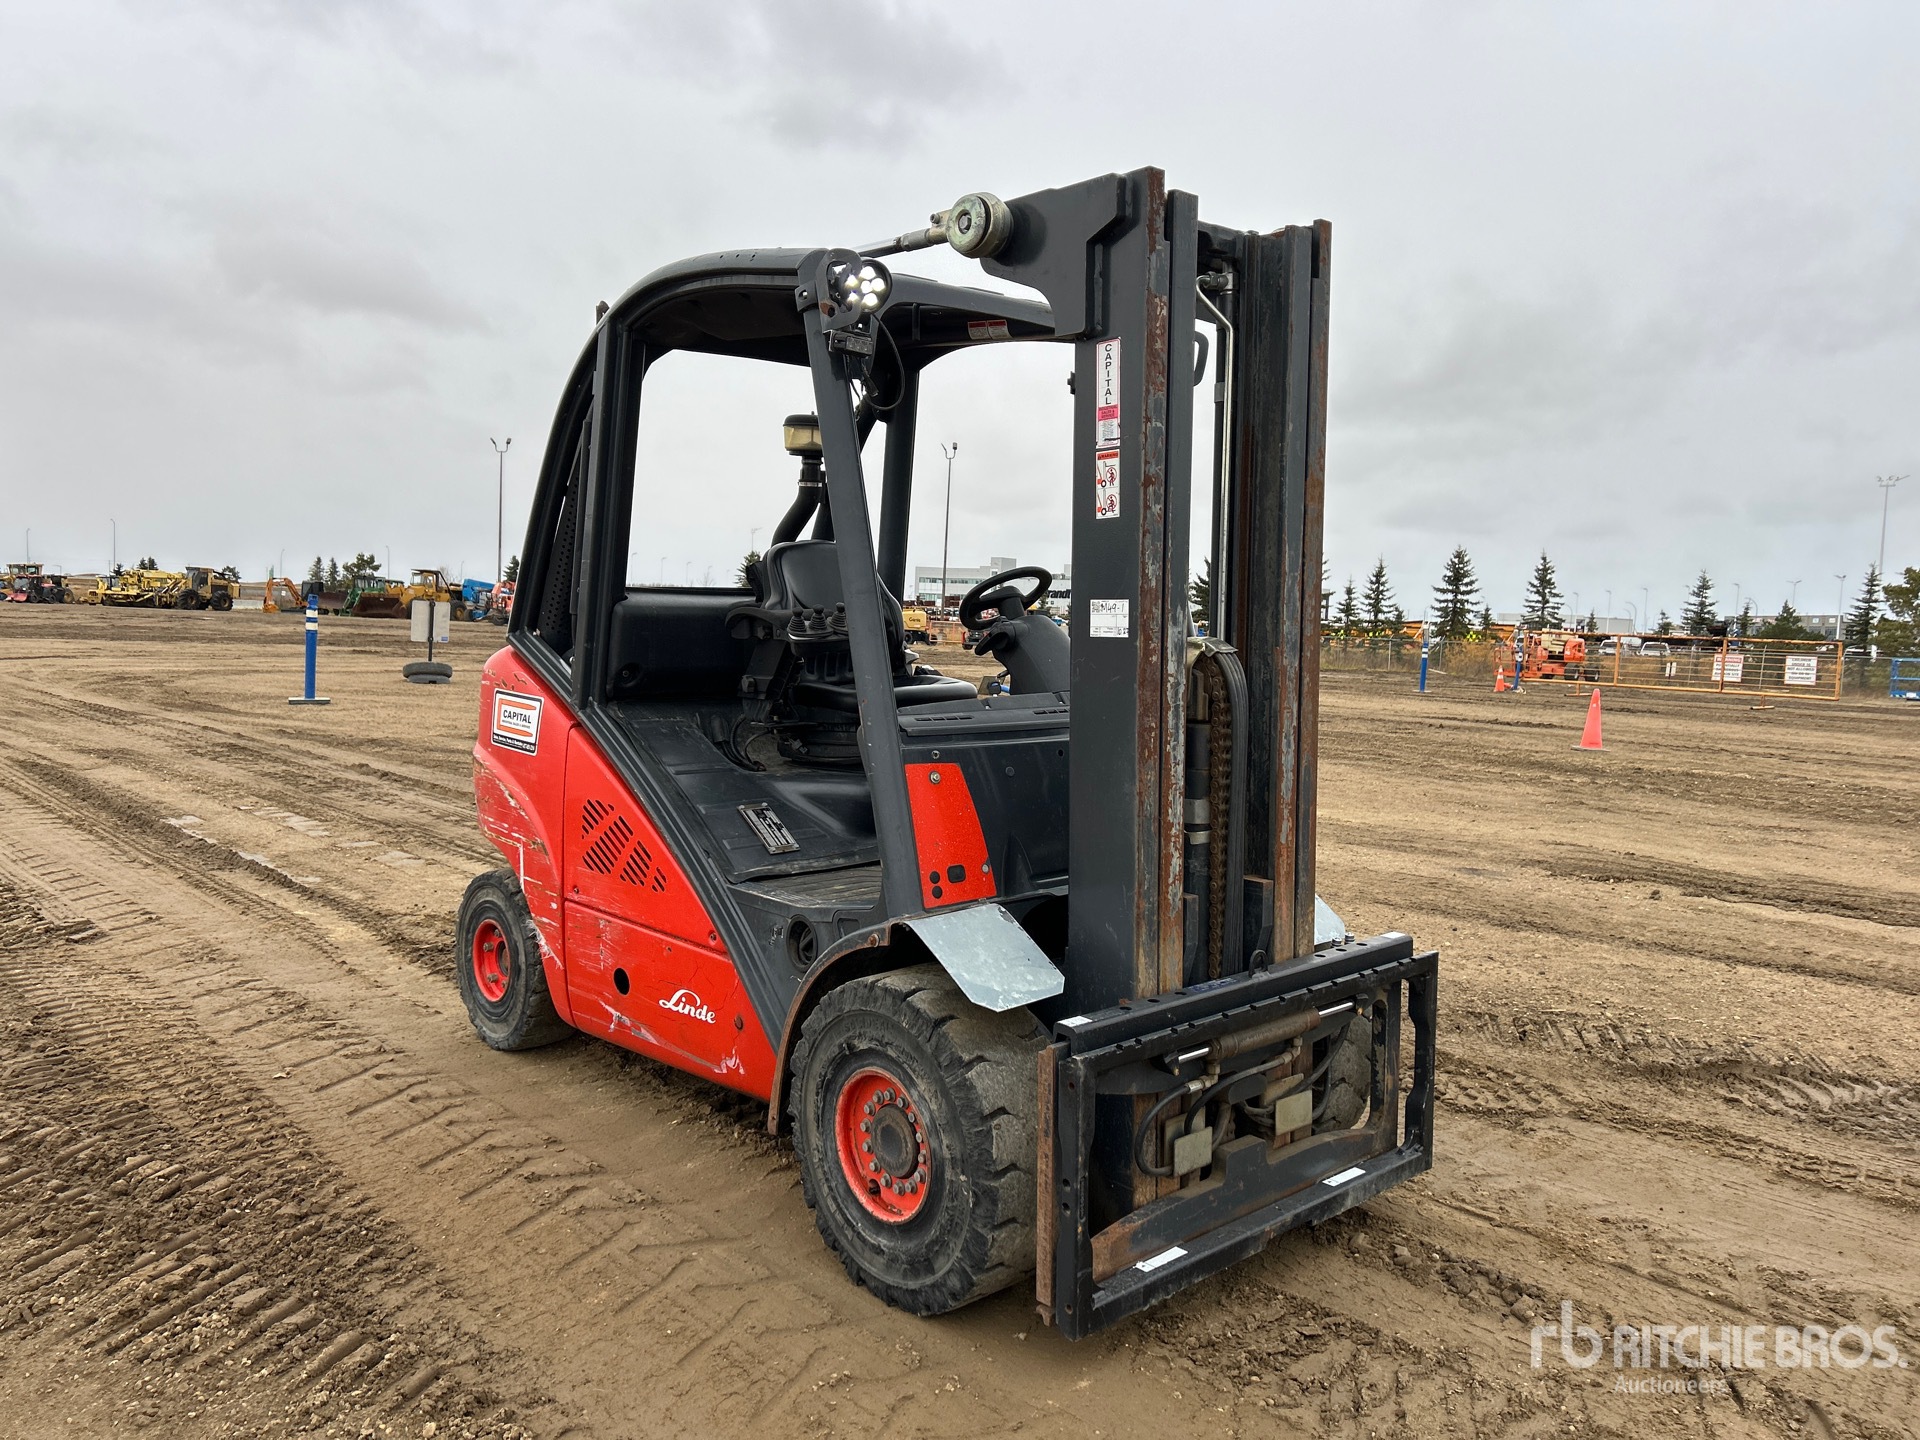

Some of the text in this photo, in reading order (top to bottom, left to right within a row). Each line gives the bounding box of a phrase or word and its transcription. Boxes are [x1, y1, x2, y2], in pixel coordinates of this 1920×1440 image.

[1104, 343, 1112, 405] CAPITAL
[503, 709, 532, 724] CAPITAL
[658, 988, 717, 1024] Linde
